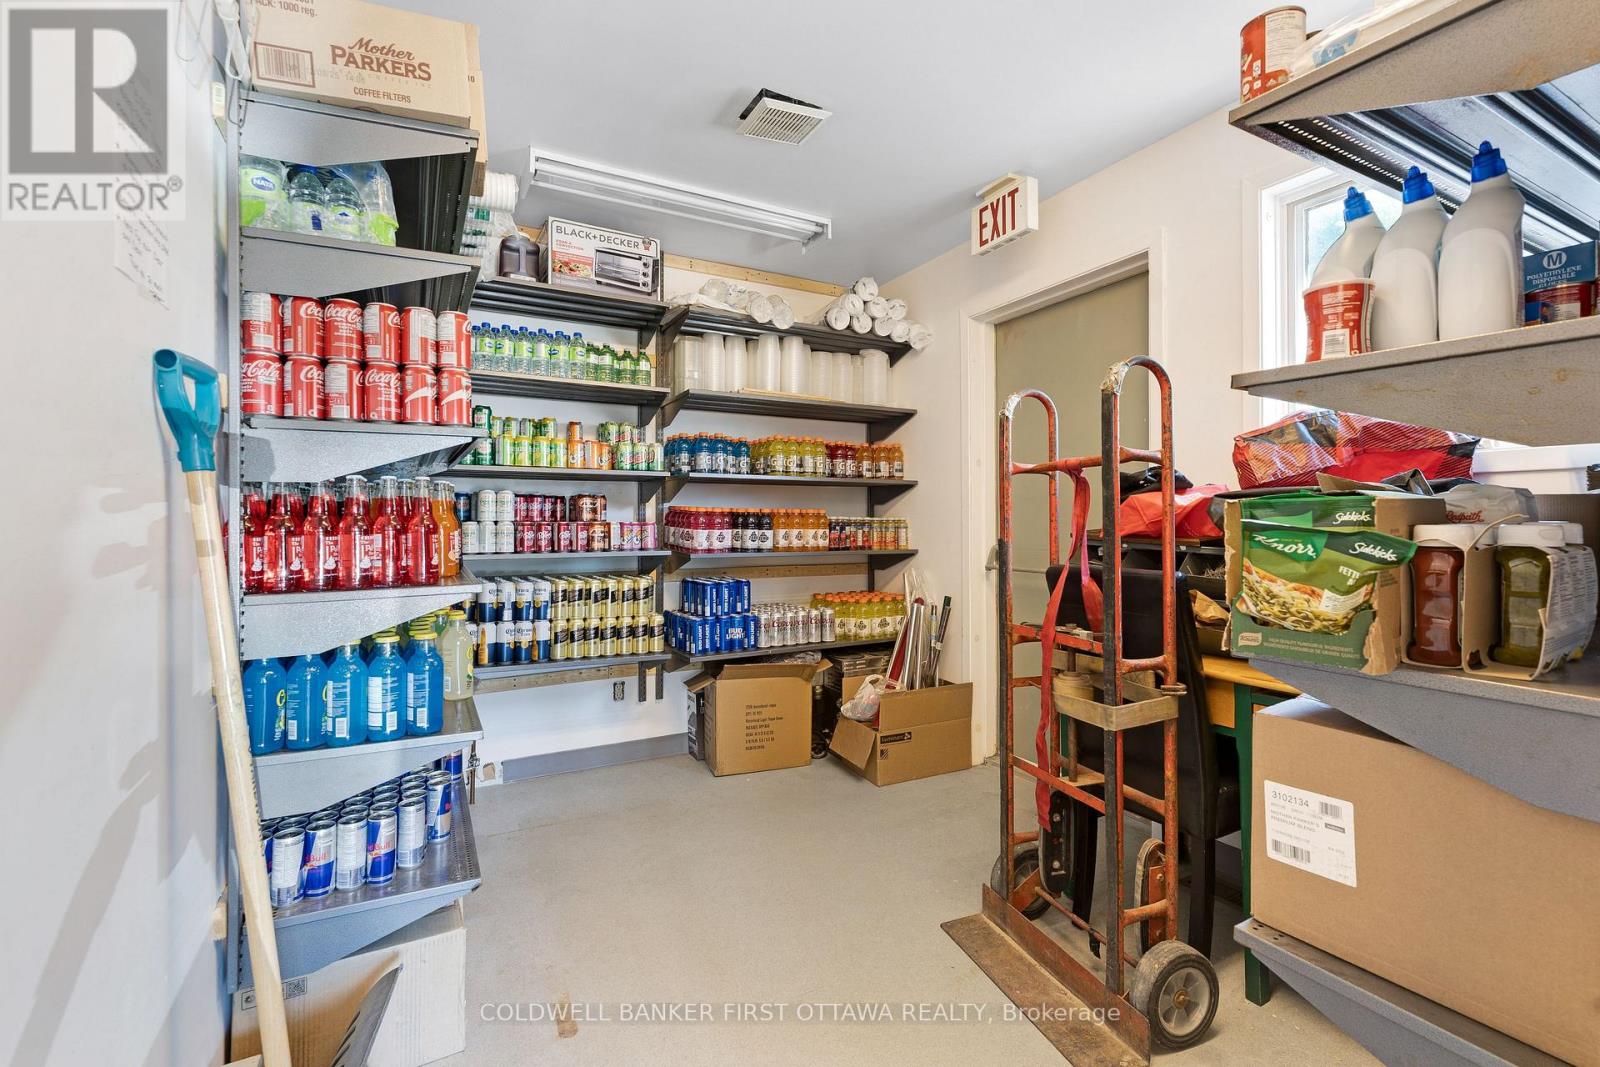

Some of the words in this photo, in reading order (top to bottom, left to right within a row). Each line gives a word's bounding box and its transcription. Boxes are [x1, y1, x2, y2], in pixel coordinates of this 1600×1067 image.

[348, 37, 415, 61] Mother
[330, 44, 432, 82] PARKERS
[353, 86, 381, 99] COFFEE
[382, 91, 412, 104] FILTERS
[979, 187, 1019, 247] EXIT
[1547, 252, 1562, 267] M
[1526, 265, 1582, 281] POLYETHYLENE
[1532, 272, 1577, 286] DISPOSABLE
[1332, 511, 1372, 525] Sidekicks
[1252, 534, 1317, 559] Knorr
[1349, 542, 1398, 562] Sidekicks
[1271, 790, 1309, 807] 3102134
